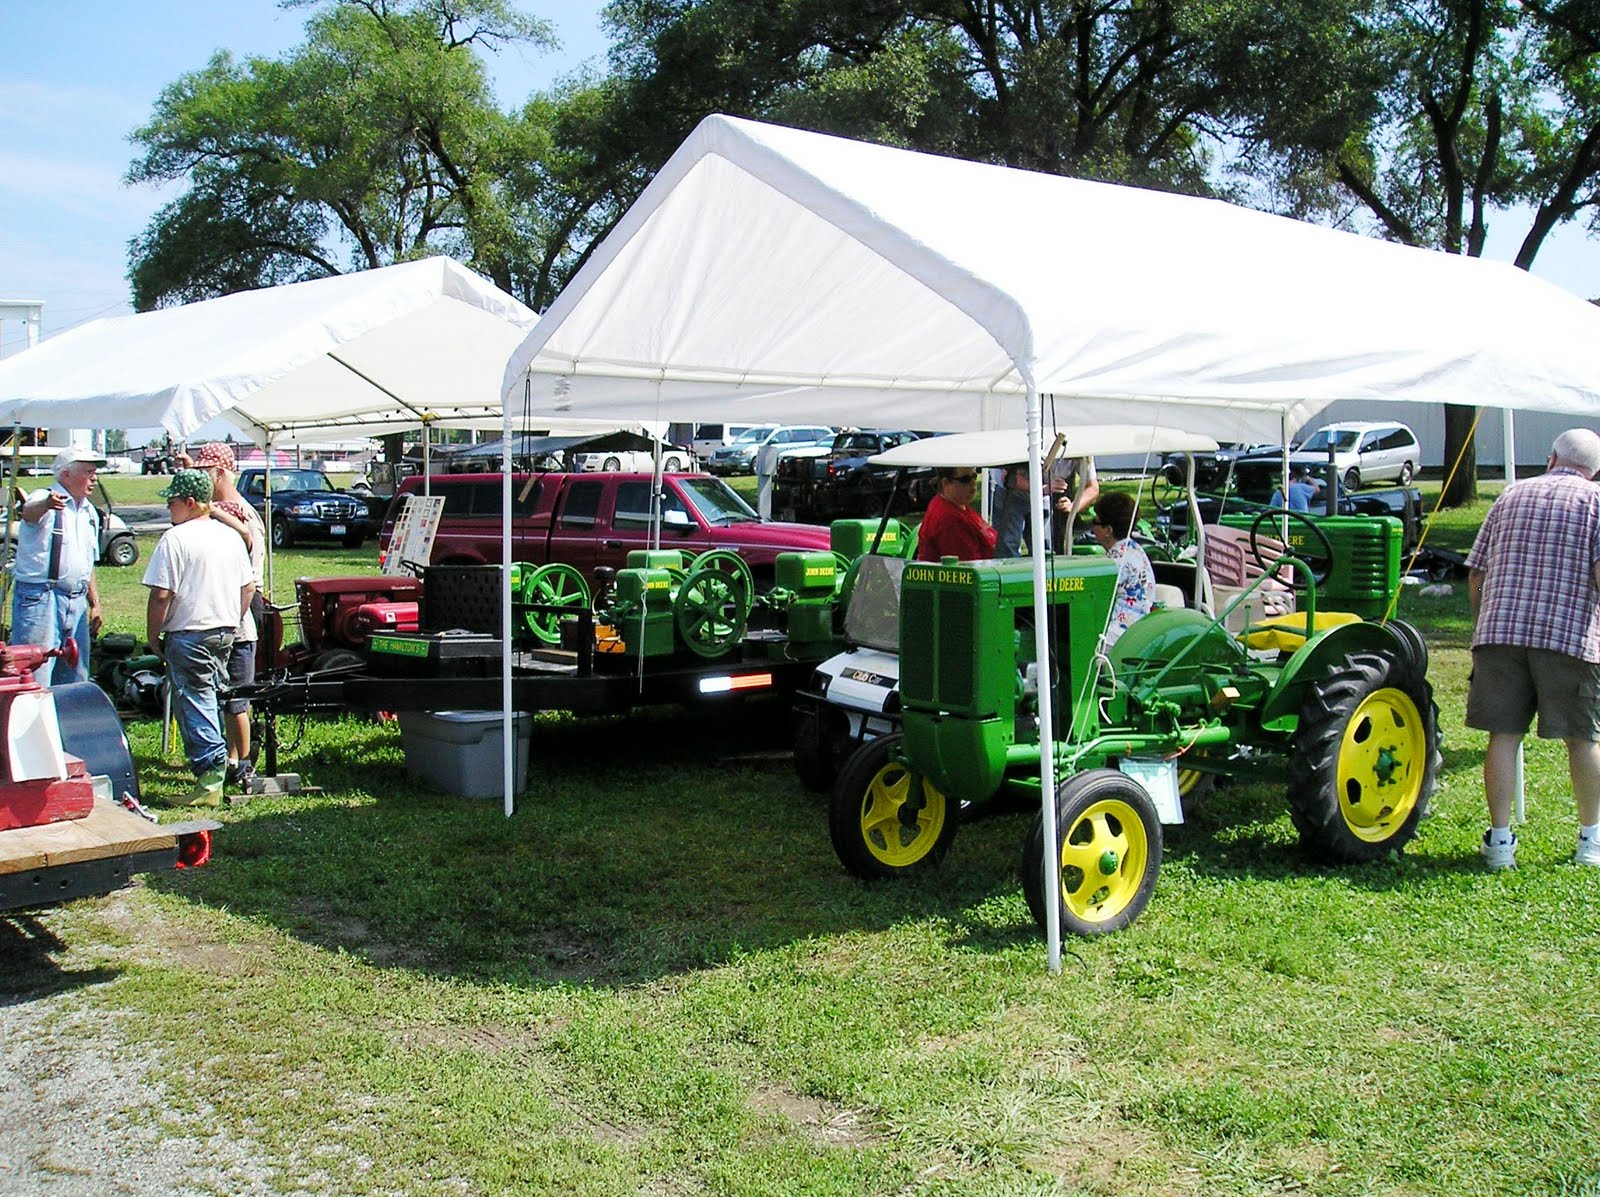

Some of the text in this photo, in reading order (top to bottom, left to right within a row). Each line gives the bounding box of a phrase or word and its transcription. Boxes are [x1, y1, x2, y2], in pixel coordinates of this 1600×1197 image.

[805, 566, 835, 576] JOHN DEERE
[906, 568, 974, 585] JOHN DEERE
[655, 580, 669, 589] DEERE
[1059, 577, 1085, 592] DEERE
[378, 639, 389, 650] THE
[852, 670, 883, 685] Club Car
